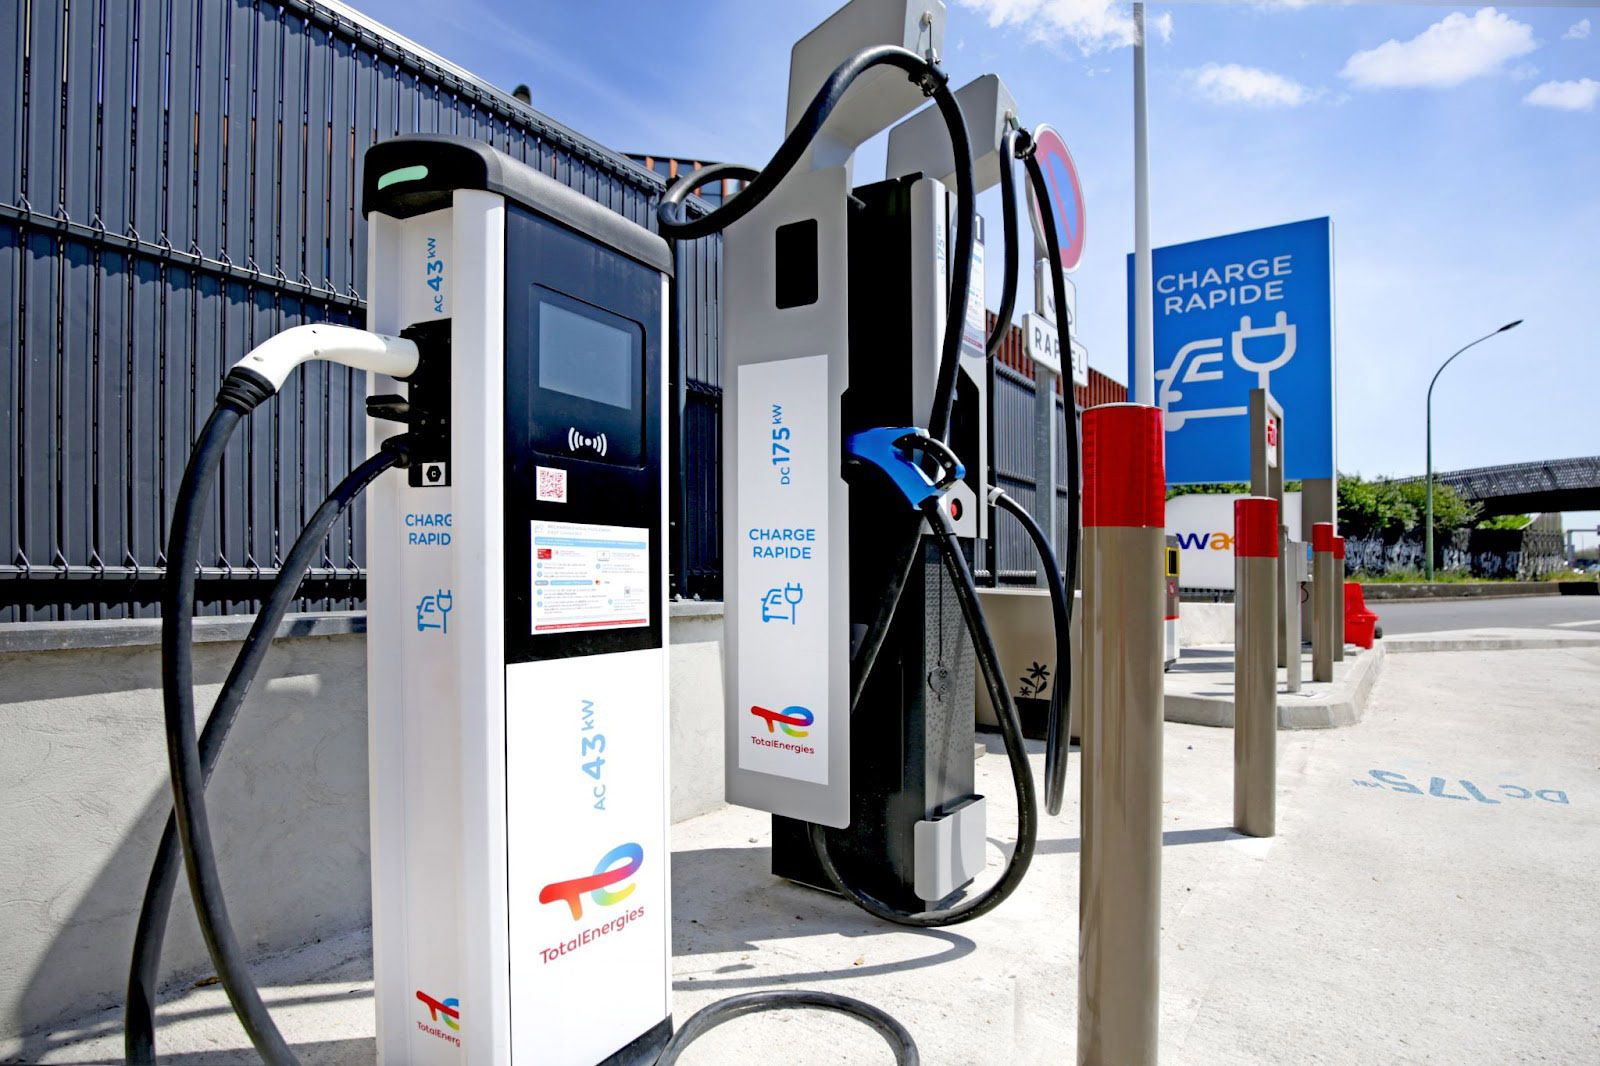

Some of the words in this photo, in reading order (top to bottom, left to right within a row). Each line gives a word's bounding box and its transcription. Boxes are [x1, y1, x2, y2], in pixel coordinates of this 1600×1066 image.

[427, 237, 436, 259] kW
[427, 260, 443, 292] 43
[1157, 254, 1293, 294] CHARGE
[434, 294, 443, 313] AC
[1165, 279, 1285, 316] RAPIDE
[1035, 326, 1084, 375] RAPEL
[773, 404, 782, 425] kW
[772, 427, 790, 466] 175
[781, 466, 790, 485] DC
[408, 532, 452, 546] RAPID
[748, 528, 816, 541] CHARGE
[1176, 531, 1235, 551] wa
[753, 546, 812, 559] RAPIDE
[581, 700, 594, 731] kW
[582, 734, 606, 780] 43
[751, 736, 815, 754] TotalEnergies
[594, 784, 606, 811] AC
[1368, 769, 1502, 805] 175
[1499, 784, 1570, 804] DC
[539, 906, 644, 964] TotalEnergies
